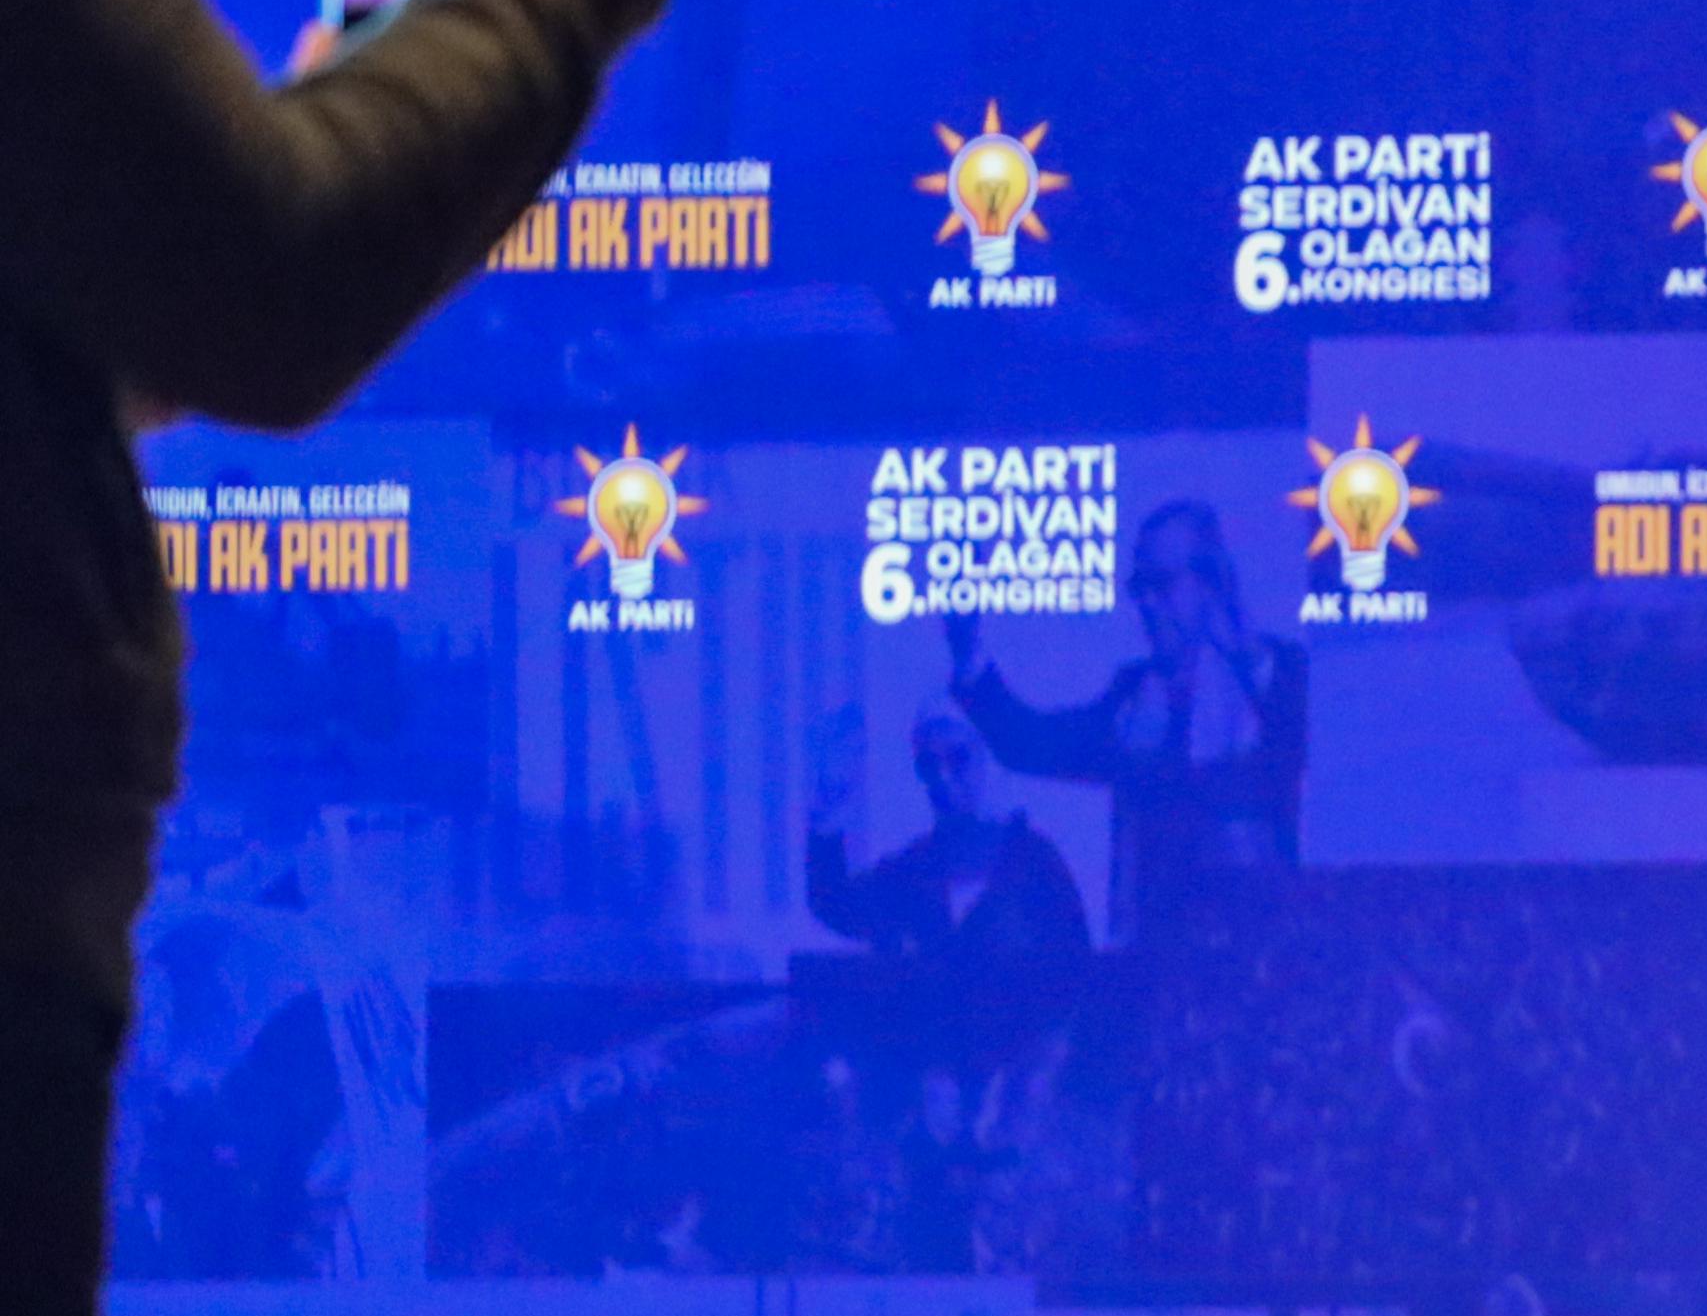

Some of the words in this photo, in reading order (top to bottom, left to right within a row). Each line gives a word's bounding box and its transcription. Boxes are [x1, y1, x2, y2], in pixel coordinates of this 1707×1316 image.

[1244, 134, 1322, 183] AK
[1239, 176, 1491, 231] SERDİVAN
[568, 197, 630, 270] AK
[928, 277, 972, 308] AK
[1234, 229, 1301, 313] 6.
[1300, 223, 1491, 269] OLAĞAN
[1662, 267, 1707, 297] AK
[871, 446, 949, 495] AK
[866, 487, 1116, 541] SERDİVAN
[1593, 503, 1672, 577] ADI
[209, 519, 269, 593] AK
[861, 540, 928, 625] 6.
[926, 534, 1116, 580] OLAĞAN
[567, 601, 610, 631] AK
[1297, 592, 1344, 623] AK
